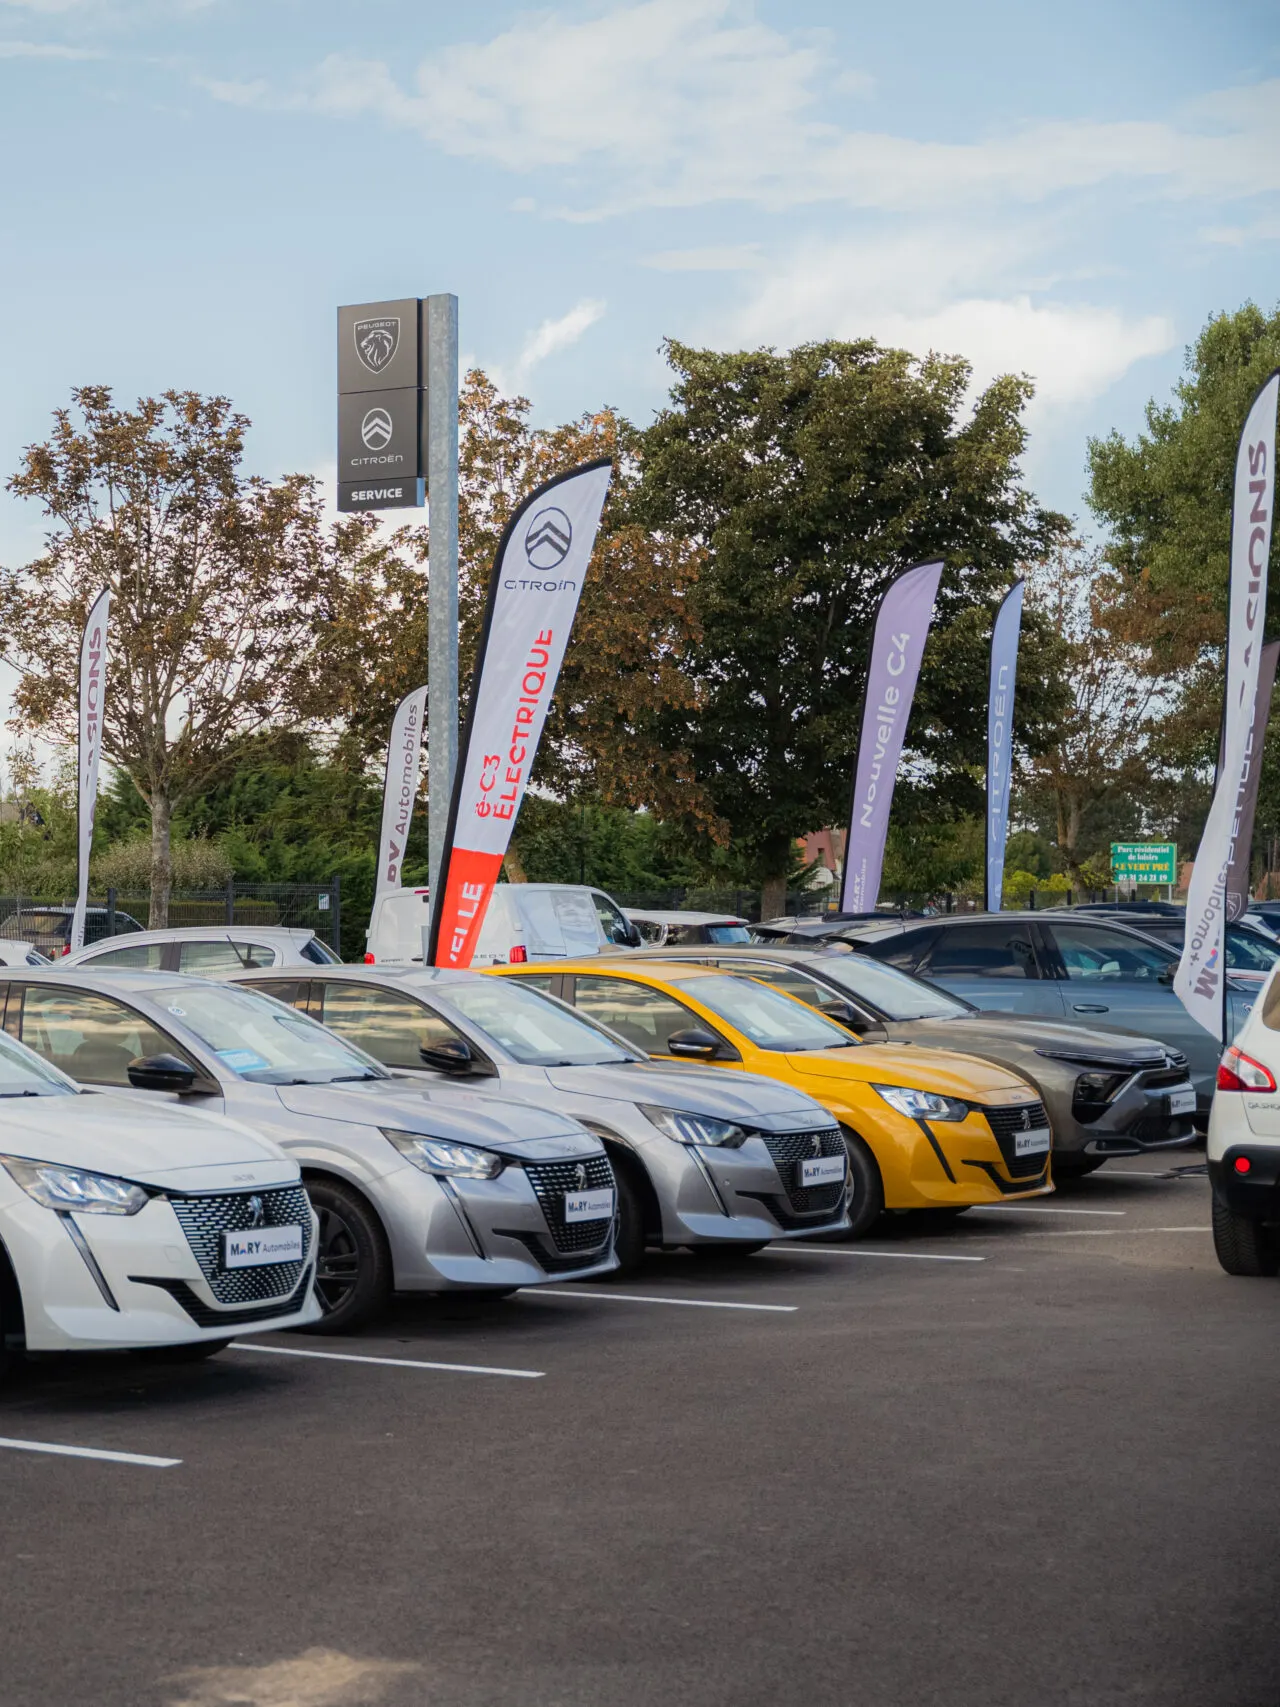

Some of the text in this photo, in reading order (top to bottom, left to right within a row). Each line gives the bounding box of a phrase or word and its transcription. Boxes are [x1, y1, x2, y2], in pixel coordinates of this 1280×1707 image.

[357, 321, 397, 331] PEUGEOT
[351, 454, 404, 466] CITROËN
[351, 488, 403, 502] SERVICE
[860, 631, 911, 828] Nouvelle C4
[395, 703, 418, 836] Automobiles
[475, 754, 501, 819] ë-C3
[1127, 863, 1150, 871] VERT
[1152, 862, 1169, 871] PRÉ
[1138, 873, 1148, 881] 24
[1159, 873, 1168, 881] 19
[567, 1200, 588, 1213] MARY
[230, 1240, 301, 1257] MARY Automobiles
